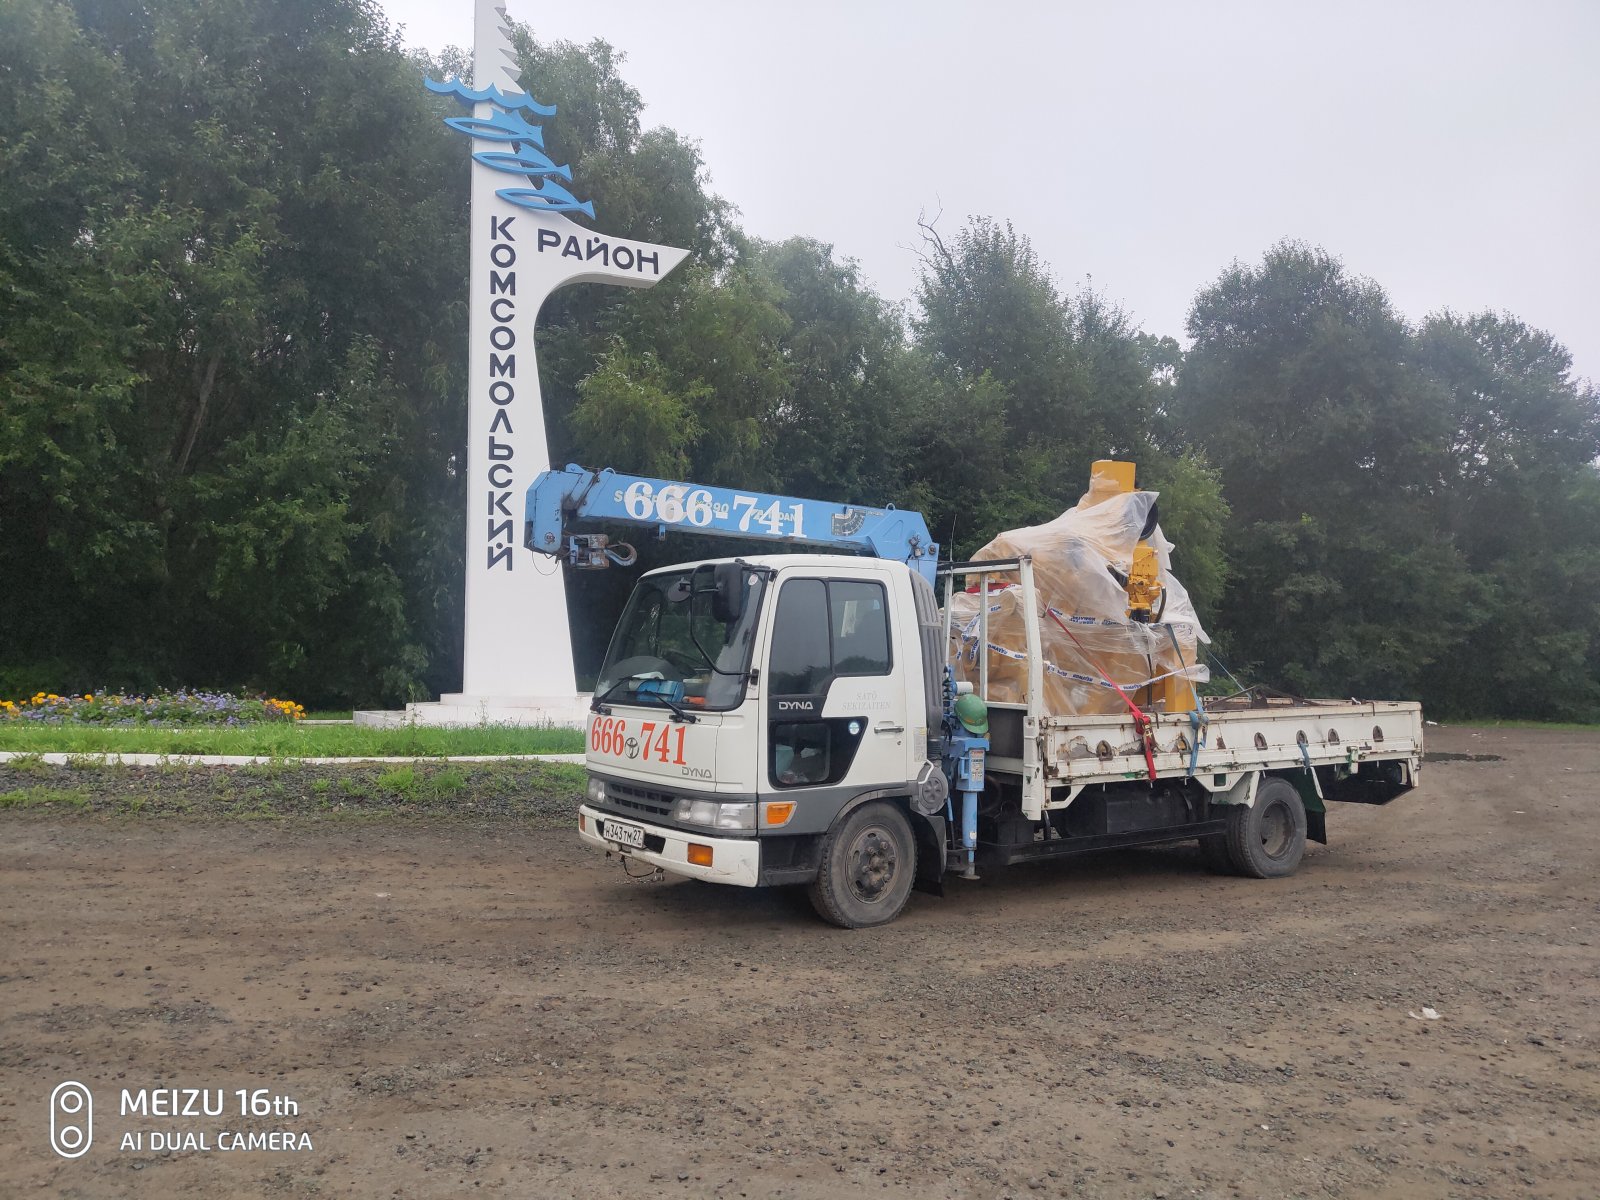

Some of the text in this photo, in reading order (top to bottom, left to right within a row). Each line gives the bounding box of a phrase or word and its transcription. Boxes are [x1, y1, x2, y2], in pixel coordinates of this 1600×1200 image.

[537, 228, 659, 275] РАЙОН
[487, 215, 516, 571] КОМСОМОЛЬСКИЙ
[624, 481, 807, 538] 666-741
[778, 701, 814, 711] DYNA
[591, 716, 687, 765] 666 741
[681, 766, 712, 779] DYNA
